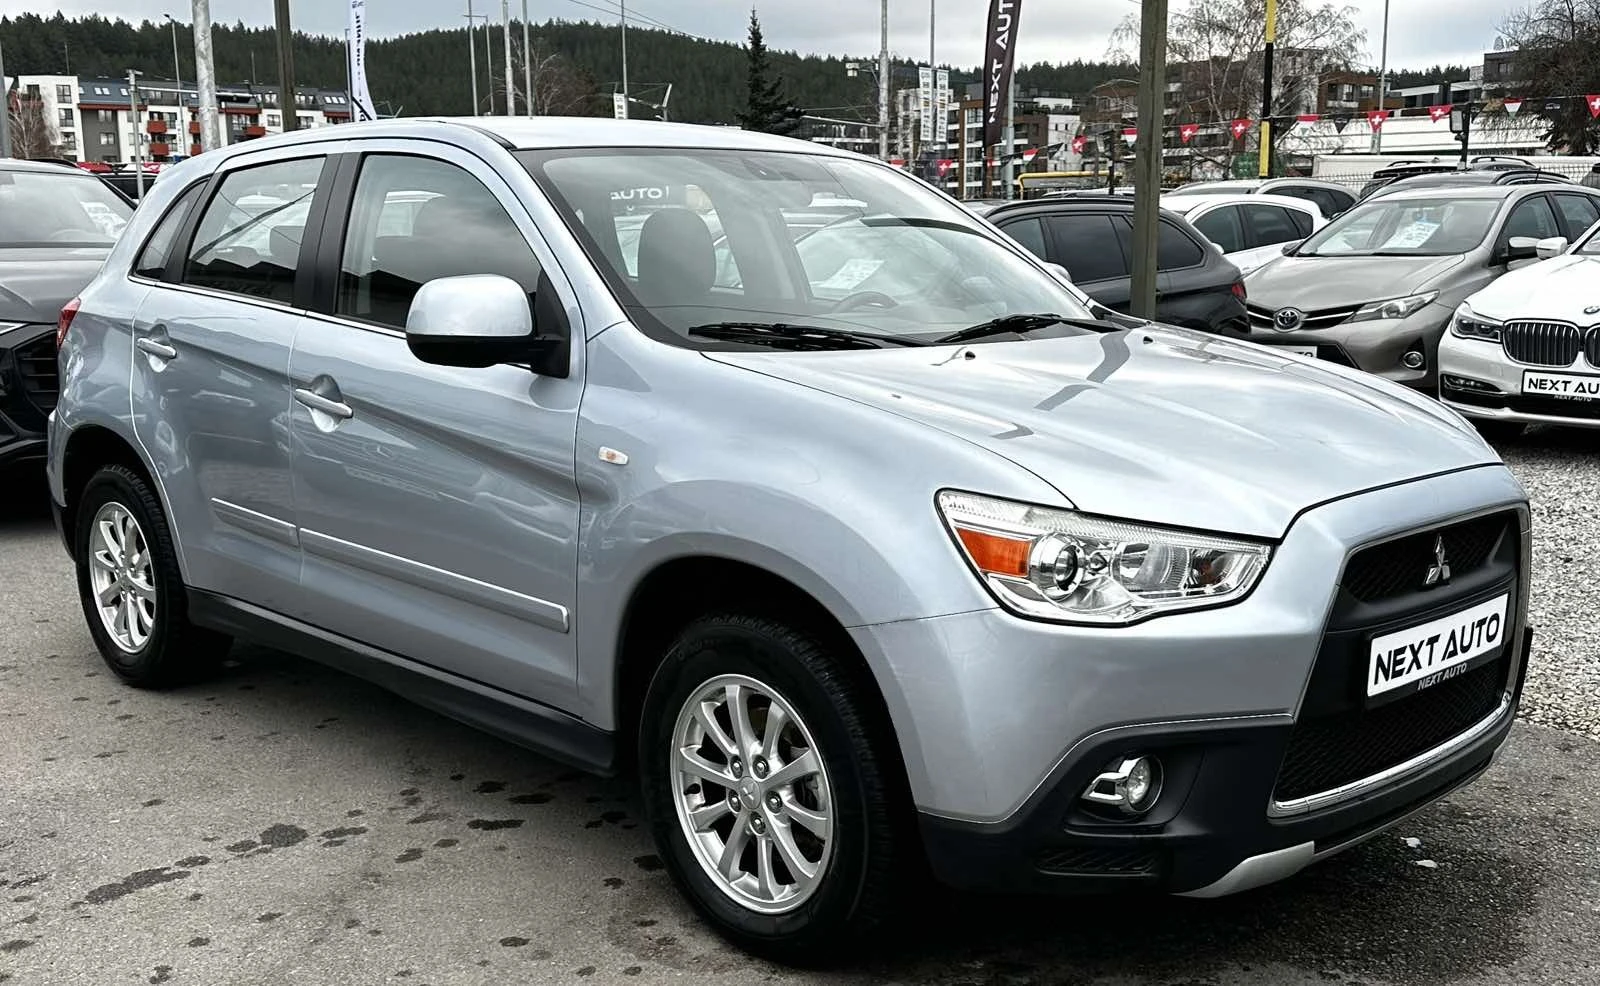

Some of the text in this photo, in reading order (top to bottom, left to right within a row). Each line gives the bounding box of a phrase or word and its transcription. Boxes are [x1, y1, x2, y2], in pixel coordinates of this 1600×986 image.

[1528, 377, 1572, 392] NEXT
[1374, 612, 1500, 686] NEXT AUTO
[1417, 662, 1467, 691] NEXT AUTO
